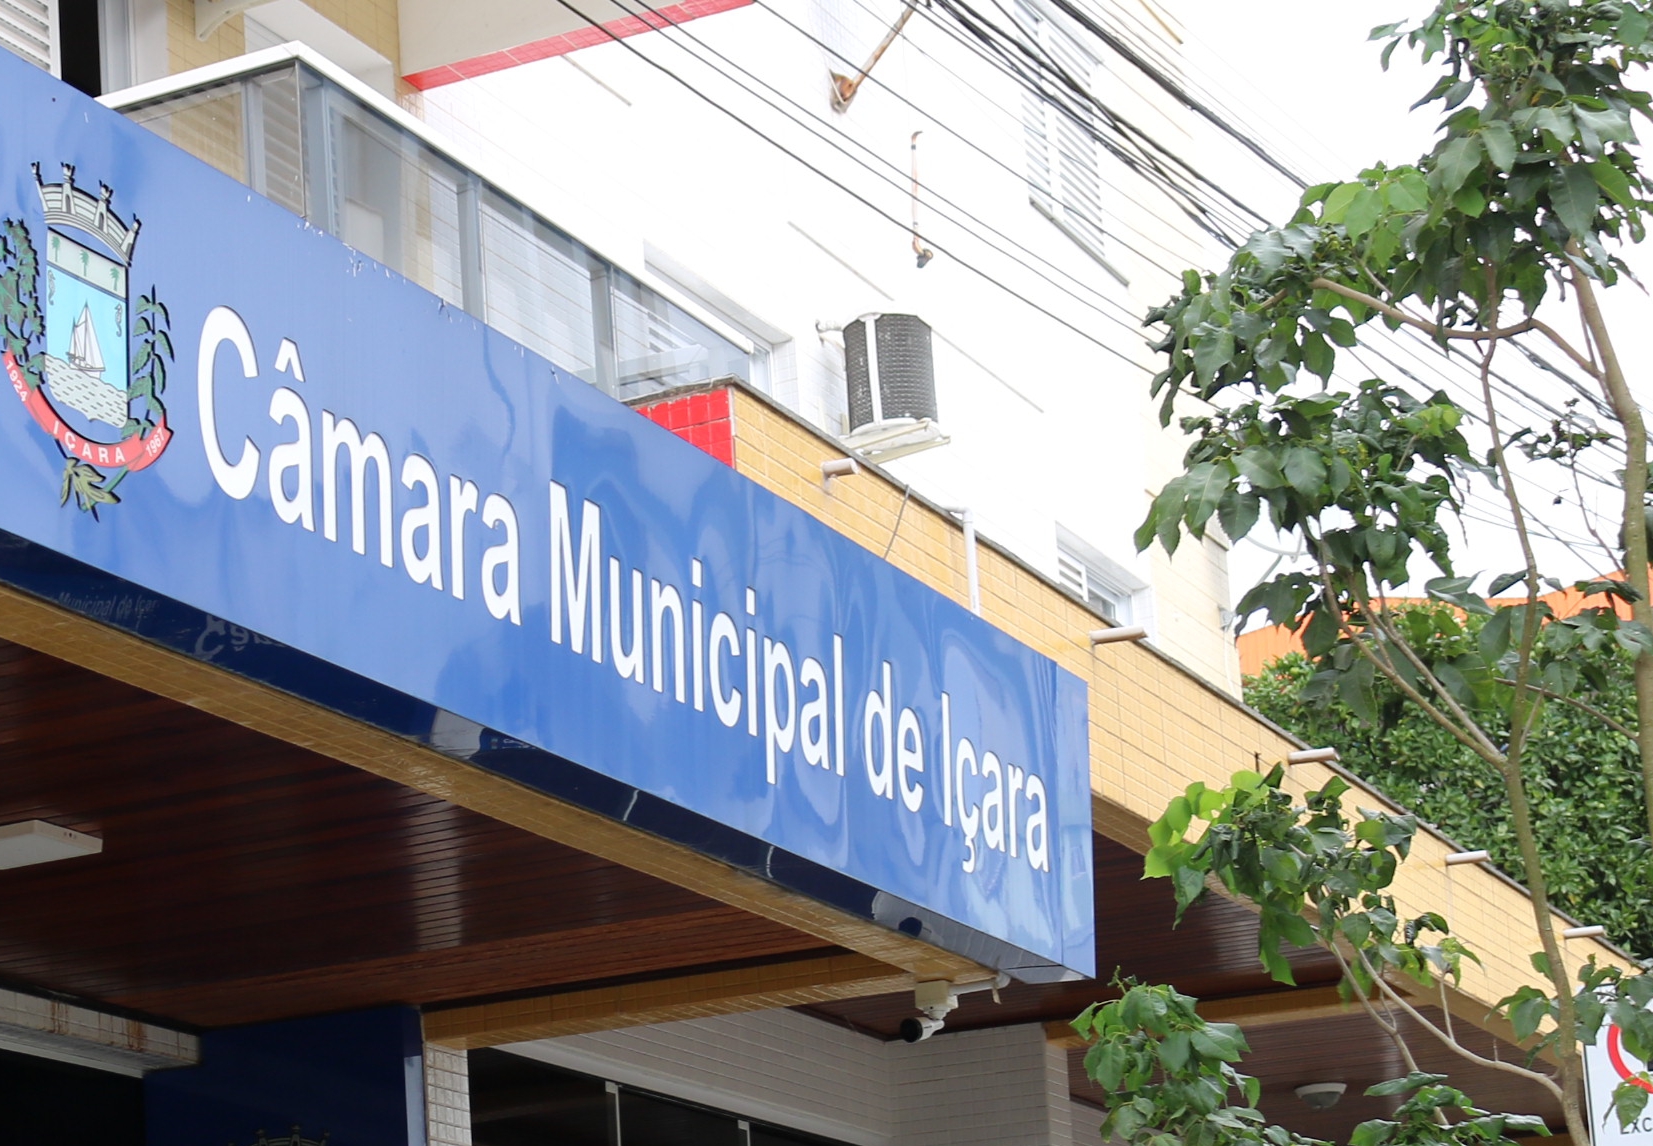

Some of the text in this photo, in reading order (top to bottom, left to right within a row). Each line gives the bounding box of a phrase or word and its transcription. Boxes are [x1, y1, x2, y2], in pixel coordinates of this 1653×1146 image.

[5, 359, 28, 402] 1924
[52, 420, 126, 464] IÇARA
[145, 427, 166, 458] 1967
[198, 305, 1050, 874] Câmara Municipal de Içara
